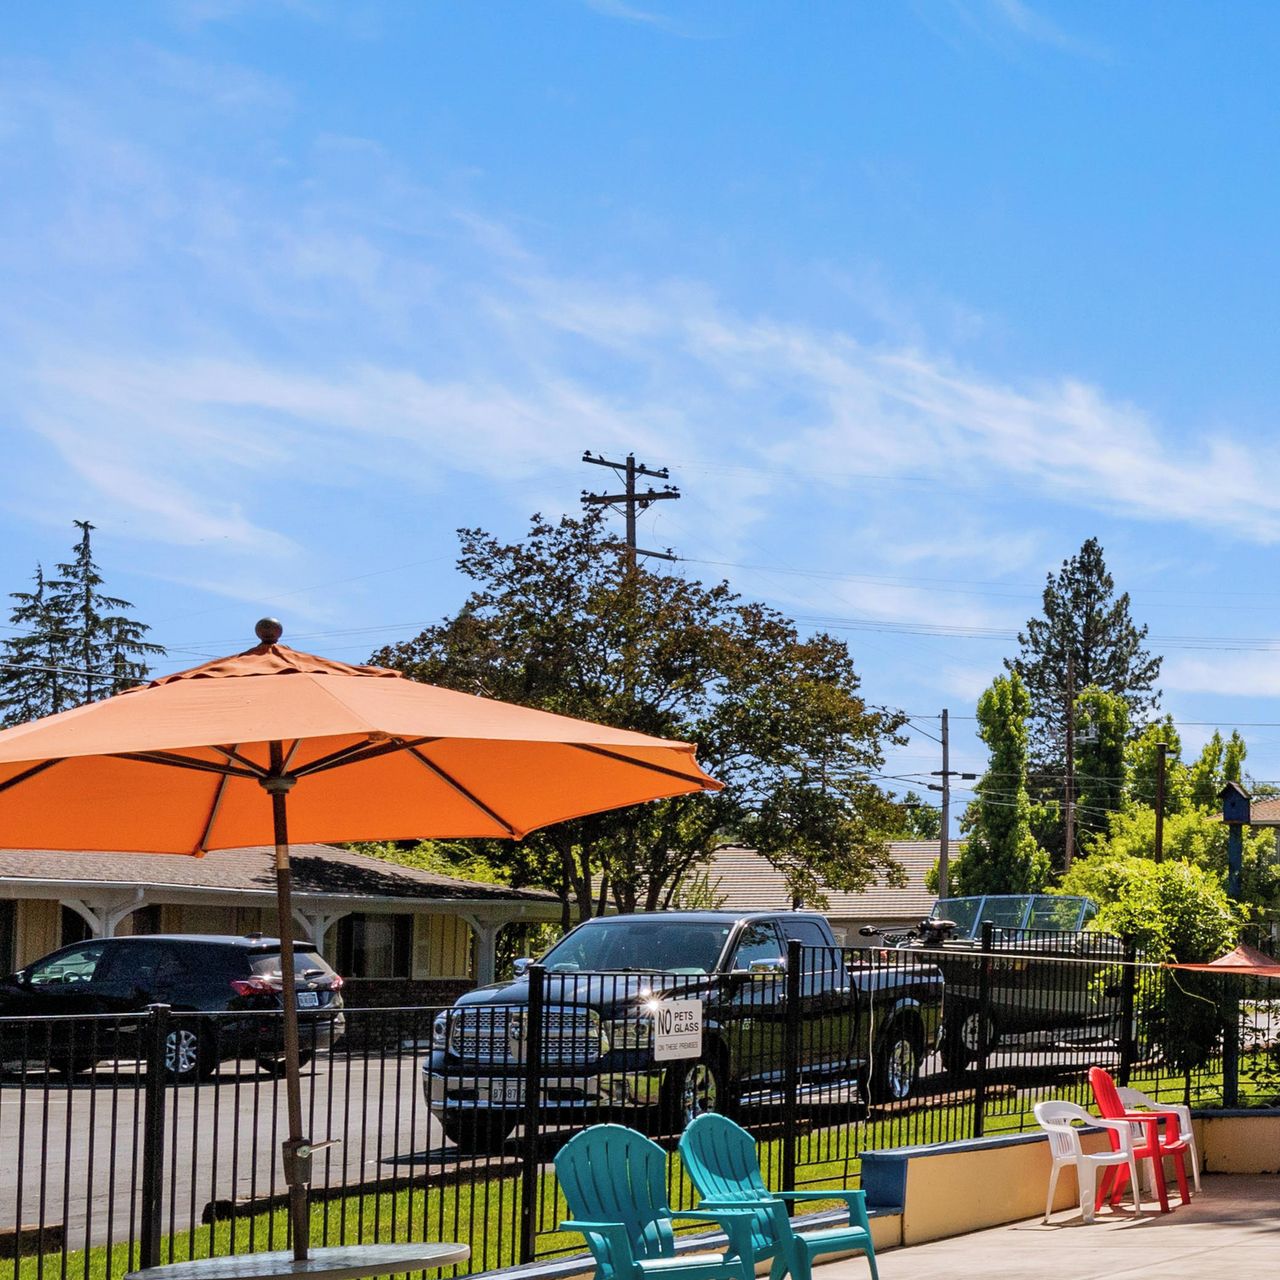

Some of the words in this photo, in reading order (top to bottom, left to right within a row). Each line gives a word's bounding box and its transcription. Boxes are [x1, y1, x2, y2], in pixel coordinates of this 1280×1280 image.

[657, 1008, 672, 1035] NO
[674, 1010, 694, 1021] PETS
[674, 1022, 699, 1033] GLASS
